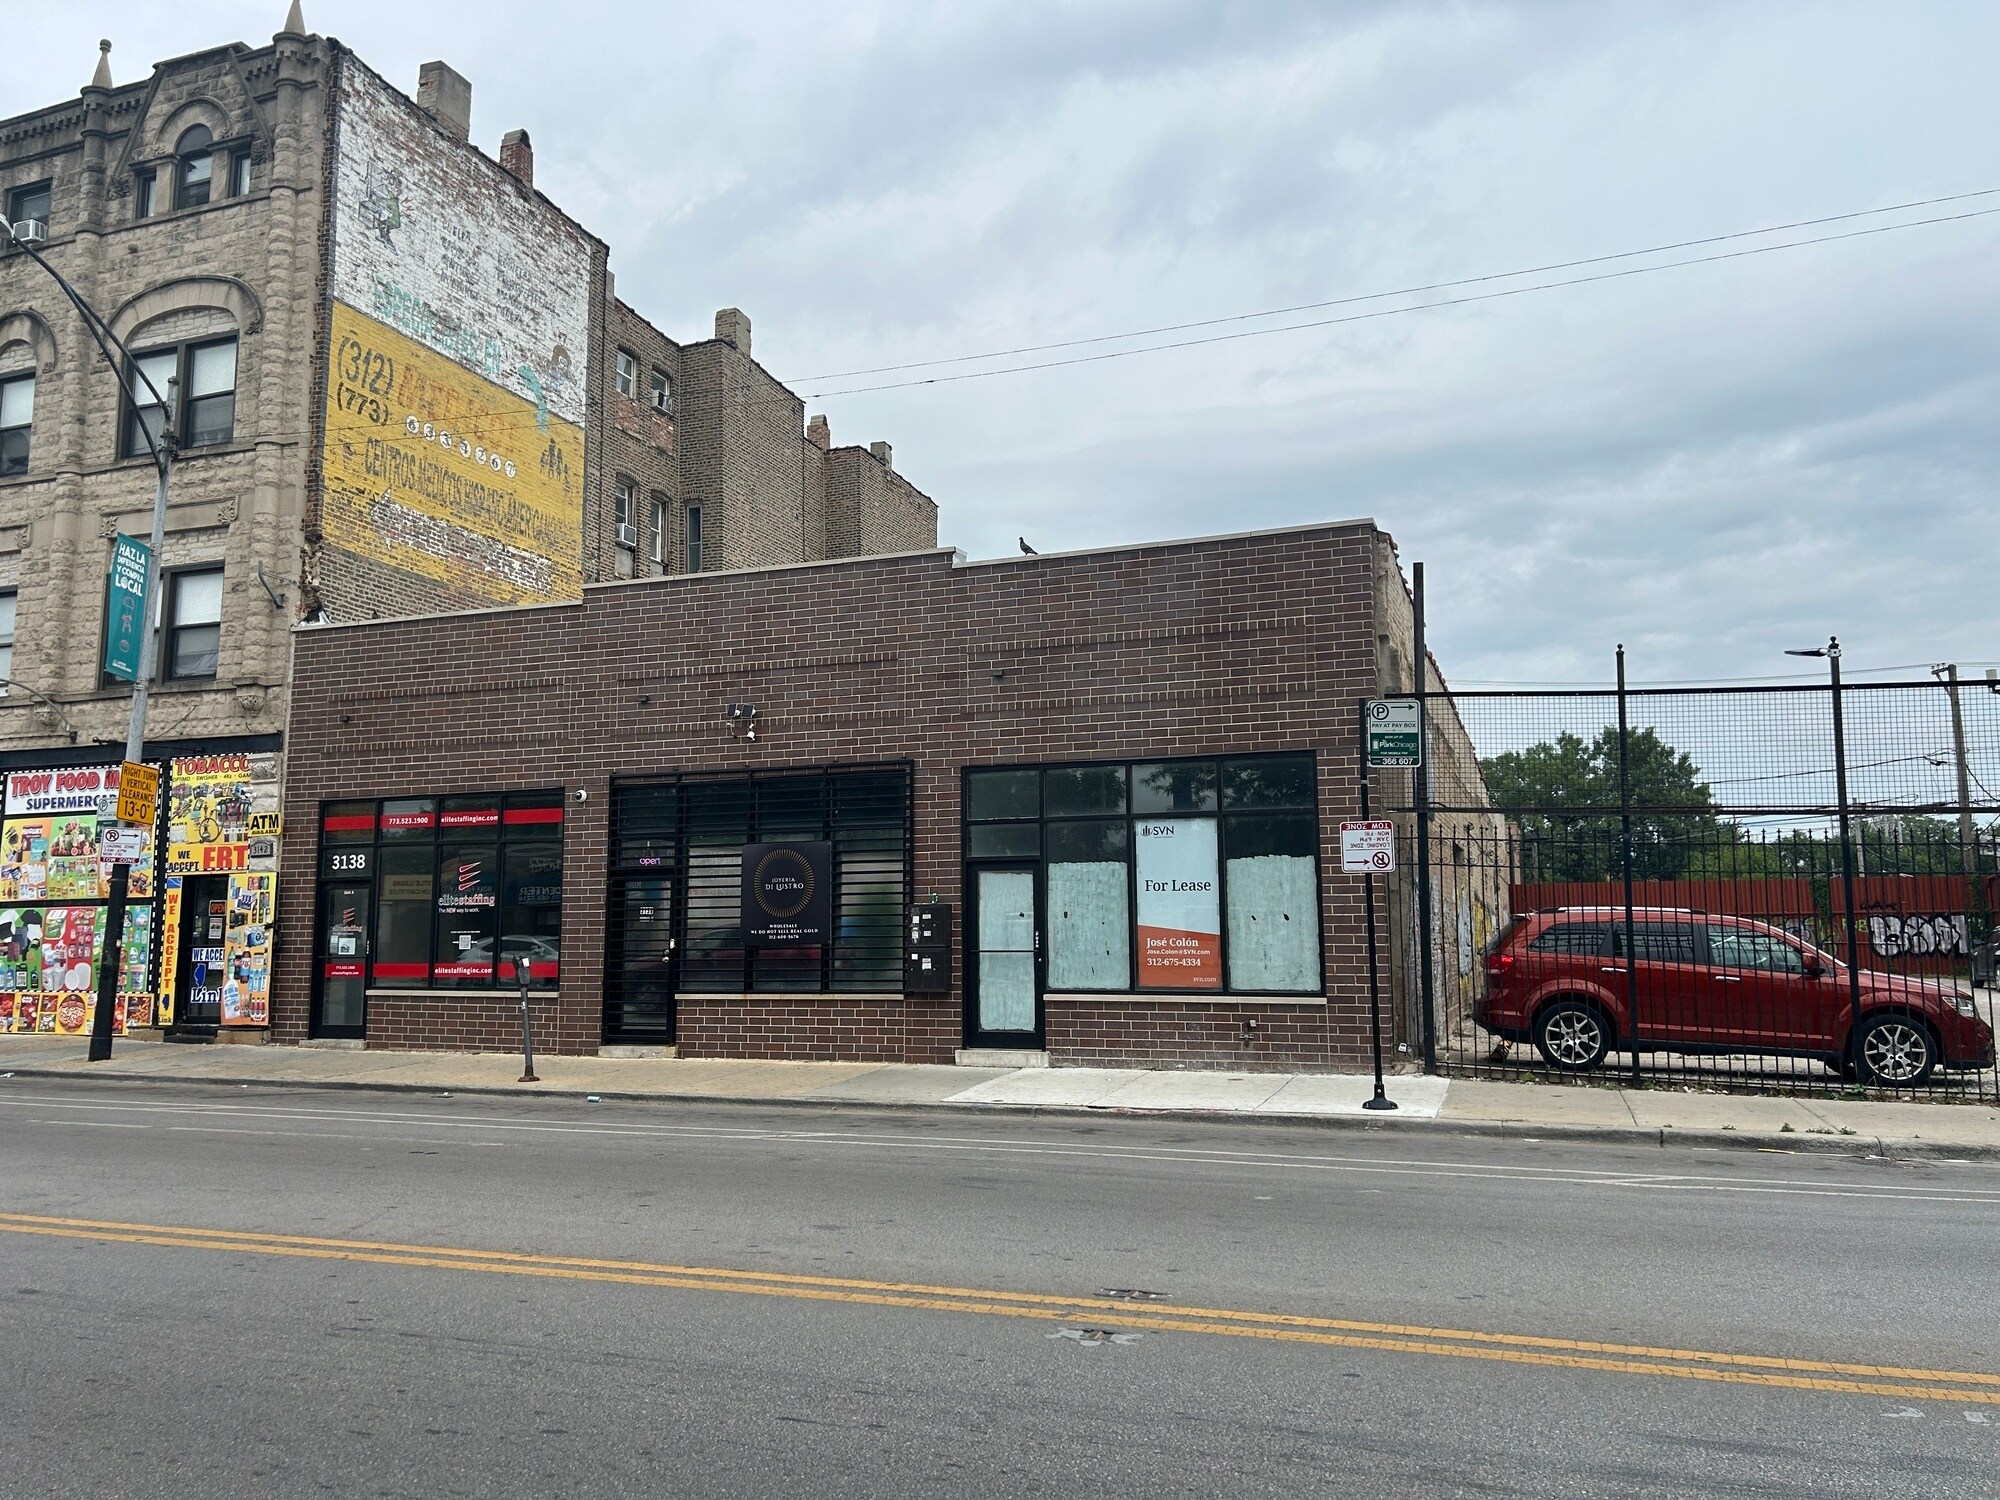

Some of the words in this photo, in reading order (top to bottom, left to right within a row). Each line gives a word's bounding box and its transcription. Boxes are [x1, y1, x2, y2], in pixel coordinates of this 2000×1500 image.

[338, 335, 394, 400] (312)
[337, 381, 389, 427] (773)
[118, 542, 136, 561] HAZ
[136, 550, 146, 567] LA
[117, 555, 145, 575] DIFERENCIA
[116, 564, 122, 573] Y
[121, 566, 144, 584] COMPRA
[115, 573, 143, 597] LOCAL
[1379, 740, 1418, 750] ParkChicago
[1398, 757, 1413, 765] 607
[123, 766, 141, 778] RIGHT
[143, 769, 158, 781] TURN
[10, 773, 53, 798] TROY
[55, 770, 101, 792] FOOD
[126, 779, 153, 793] VERTICAL
[26, 794, 118, 811] SUPERMERC
[121, 787, 155, 804] CLEARANCE
[250, 813, 280, 830] ATM
[388, 817, 429, 825] 773.523.1900
[1345, 822, 1367, 830] ZONE
[1152, 825, 1175, 836] SVN
[177, 850, 191, 860] WE
[252, 845, 269, 857] 3142
[167, 861, 200, 872] ACCEPT
[331, 854, 366, 870] 3138
[639, 857, 661, 867] open
[776, 882, 804, 891] LUSTRO
[1144, 879, 1169, 892] For
[1171, 879, 1212, 892] Lease
[168, 894, 179, 916] WE
[210, 902, 226, 912] OPEN
[437, 893, 496, 907] elitestaffing
[1146, 937, 1167, 949] José
[1169, 937, 1199, 947] Colón
[163, 923, 176, 989] ACCEPT
[193, 948, 204, 960] WE
[205, 948, 224, 960] ACCE
[1147, 957, 1202, 967] 312-675-4334
